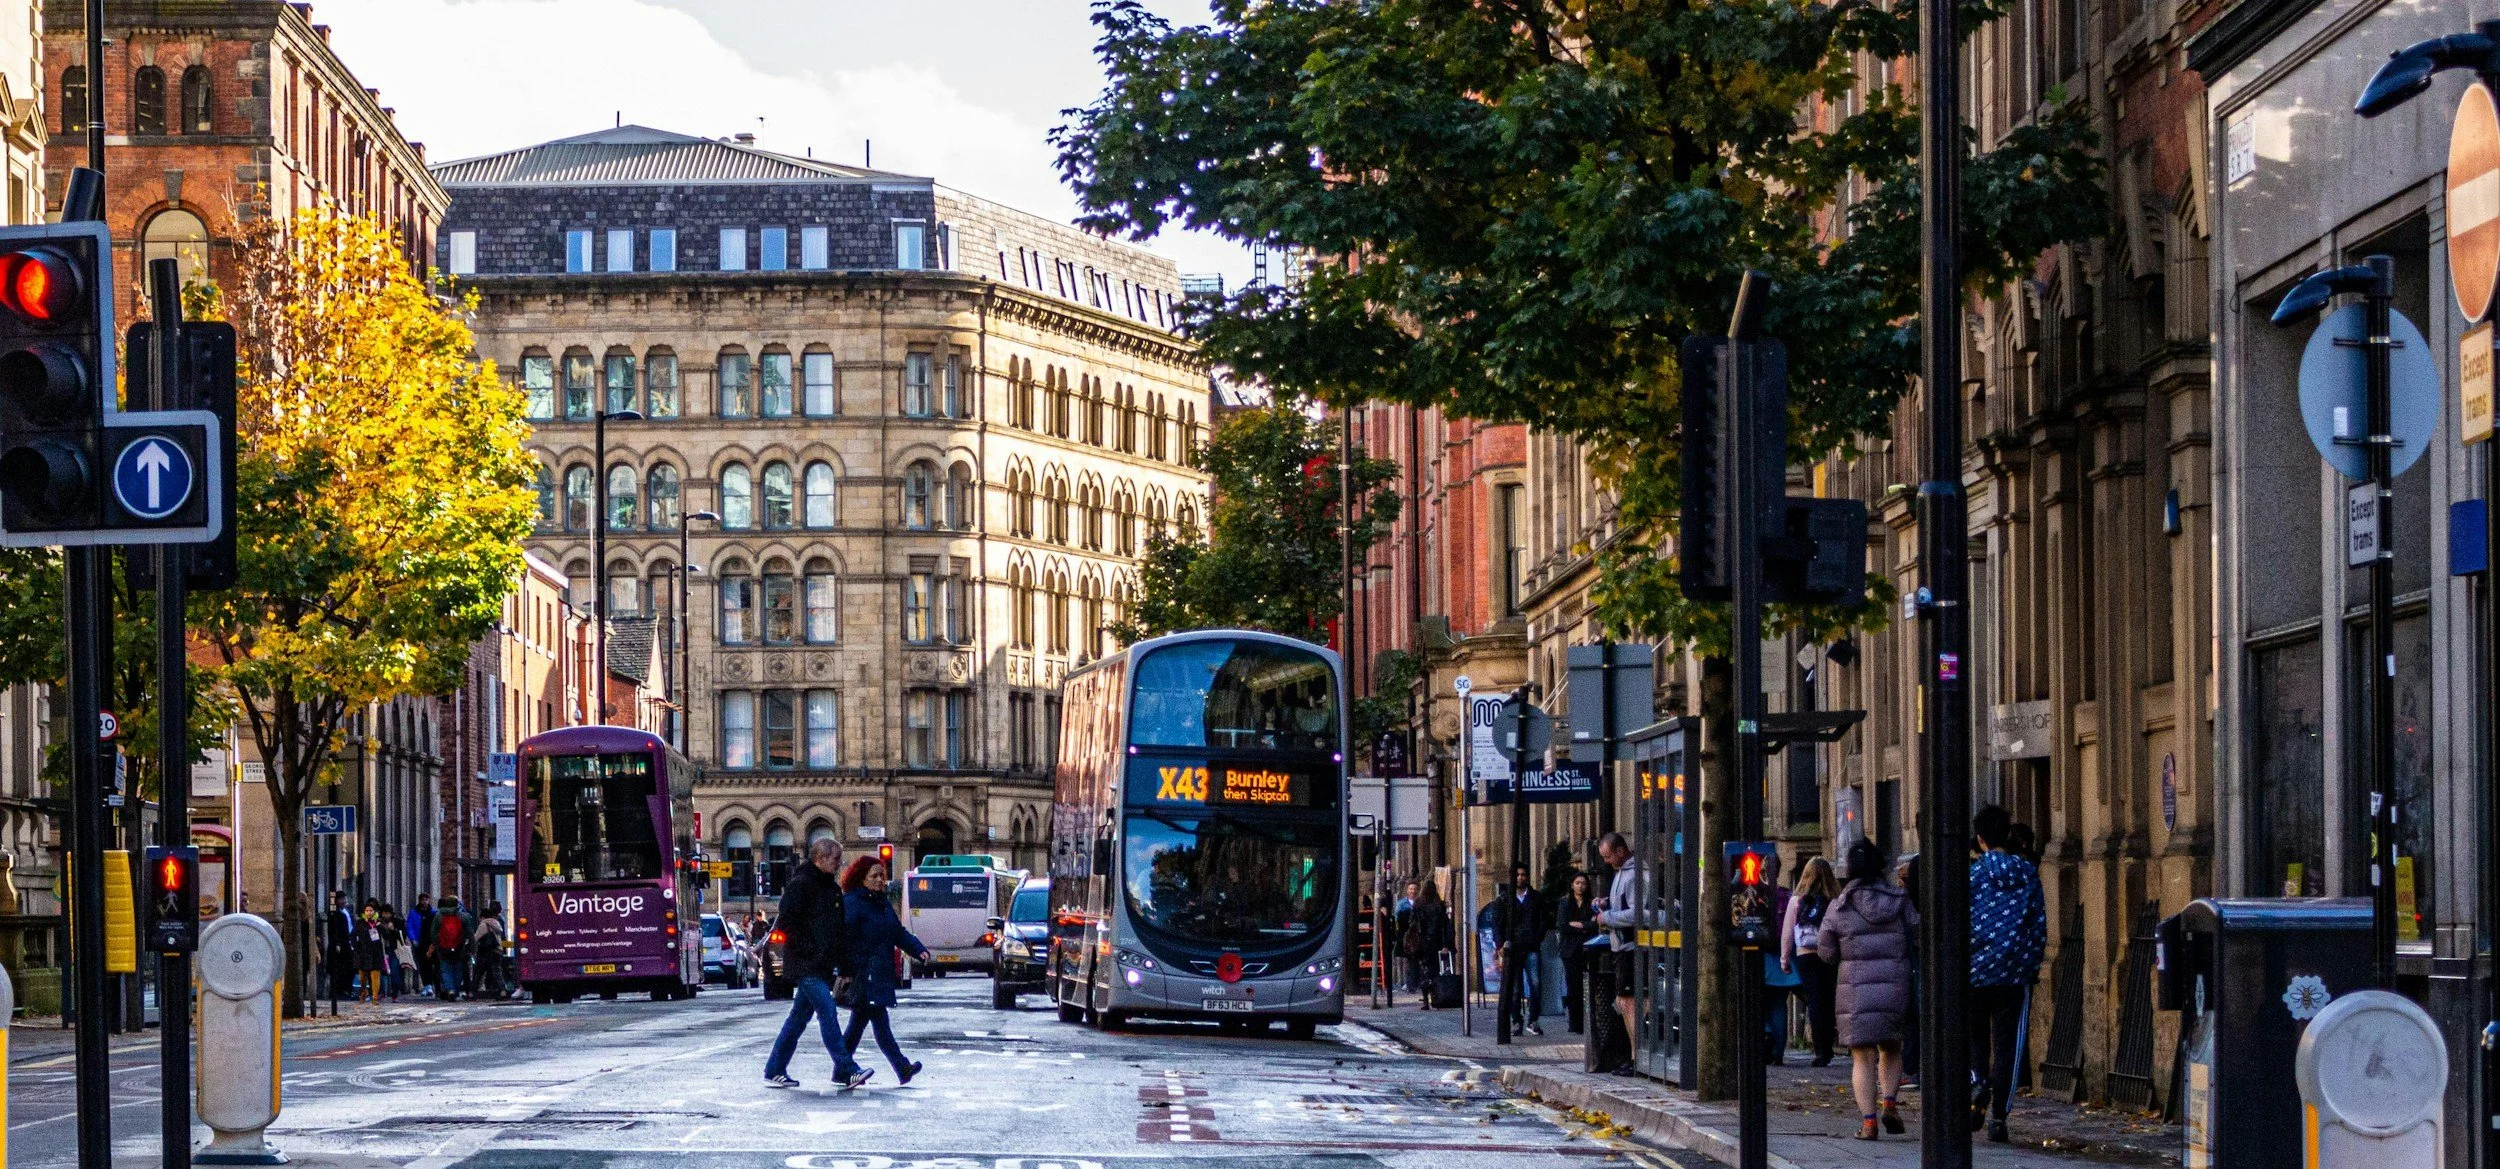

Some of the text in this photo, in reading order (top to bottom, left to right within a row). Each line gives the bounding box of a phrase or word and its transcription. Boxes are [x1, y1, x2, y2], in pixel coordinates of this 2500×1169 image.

[2463, 351, 2488, 382] Except
[2465, 394, 2487, 421] trams
[2351, 495, 2375, 523] Except
[2353, 530, 2374, 551] trams
[1456, 680, 1470, 689] SG
[1156, 766, 1290, 801] X43 Burnley
[1571, 777, 1591, 786] HOTEL
[1223, 788, 1289, 802] then Skipton
[543, 876, 565, 884] 39260
[548, 892, 644, 917] Vantage
[535, 930, 552, 938] Leigh
[564, 940, 633, 948] www.firstgroup.com/vantage
[1206, 1001, 1249, 1010] BF63 HCL
